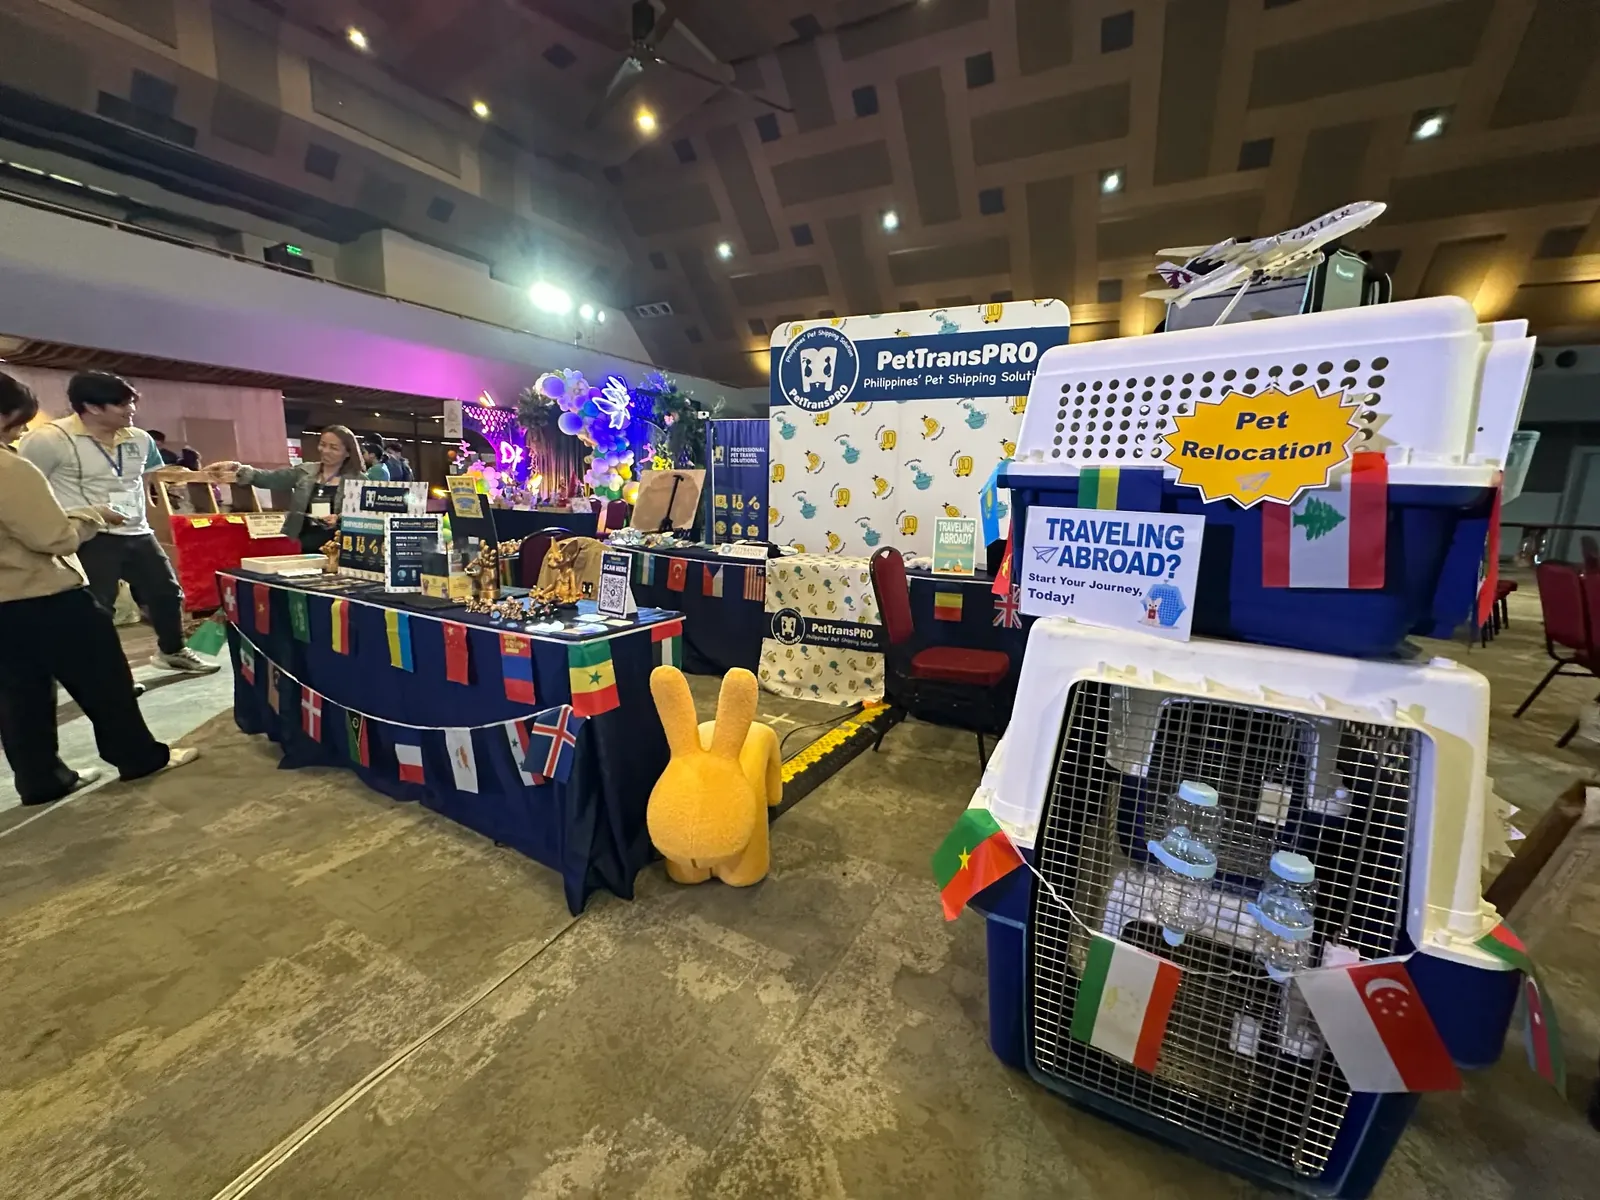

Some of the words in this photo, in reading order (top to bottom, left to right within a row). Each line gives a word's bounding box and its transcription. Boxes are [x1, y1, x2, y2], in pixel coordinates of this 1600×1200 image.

[876, 341, 1038, 371] PetTransPRO
[925, 374, 944, 386] Pet
[948, 371, 997, 387] Shipping
[1001, 370, 1037, 383] Soluti
[788, 384, 849, 410] PetTransPRO
[1235, 410, 1290, 430] Pet
[1181, 440, 1333, 461] Relocation
[938, 521, 974, 533] TRAVELING
[1045, 517, 1185, 551] TRAVELING
[939, 532, 972, 545] ABROAD?
[603, 563, 615, 572] SCAN
[1057, 545, 1182, 579] ABROAD?
[1028, 573, 1057, 584] Start
[1060, 577, 1086, 588] Your
[1089, 580, 1143, 597] Journey,
[1027, 588, 1075, 605] Today!
[811, 623, 874, 640] PetTransPRO
